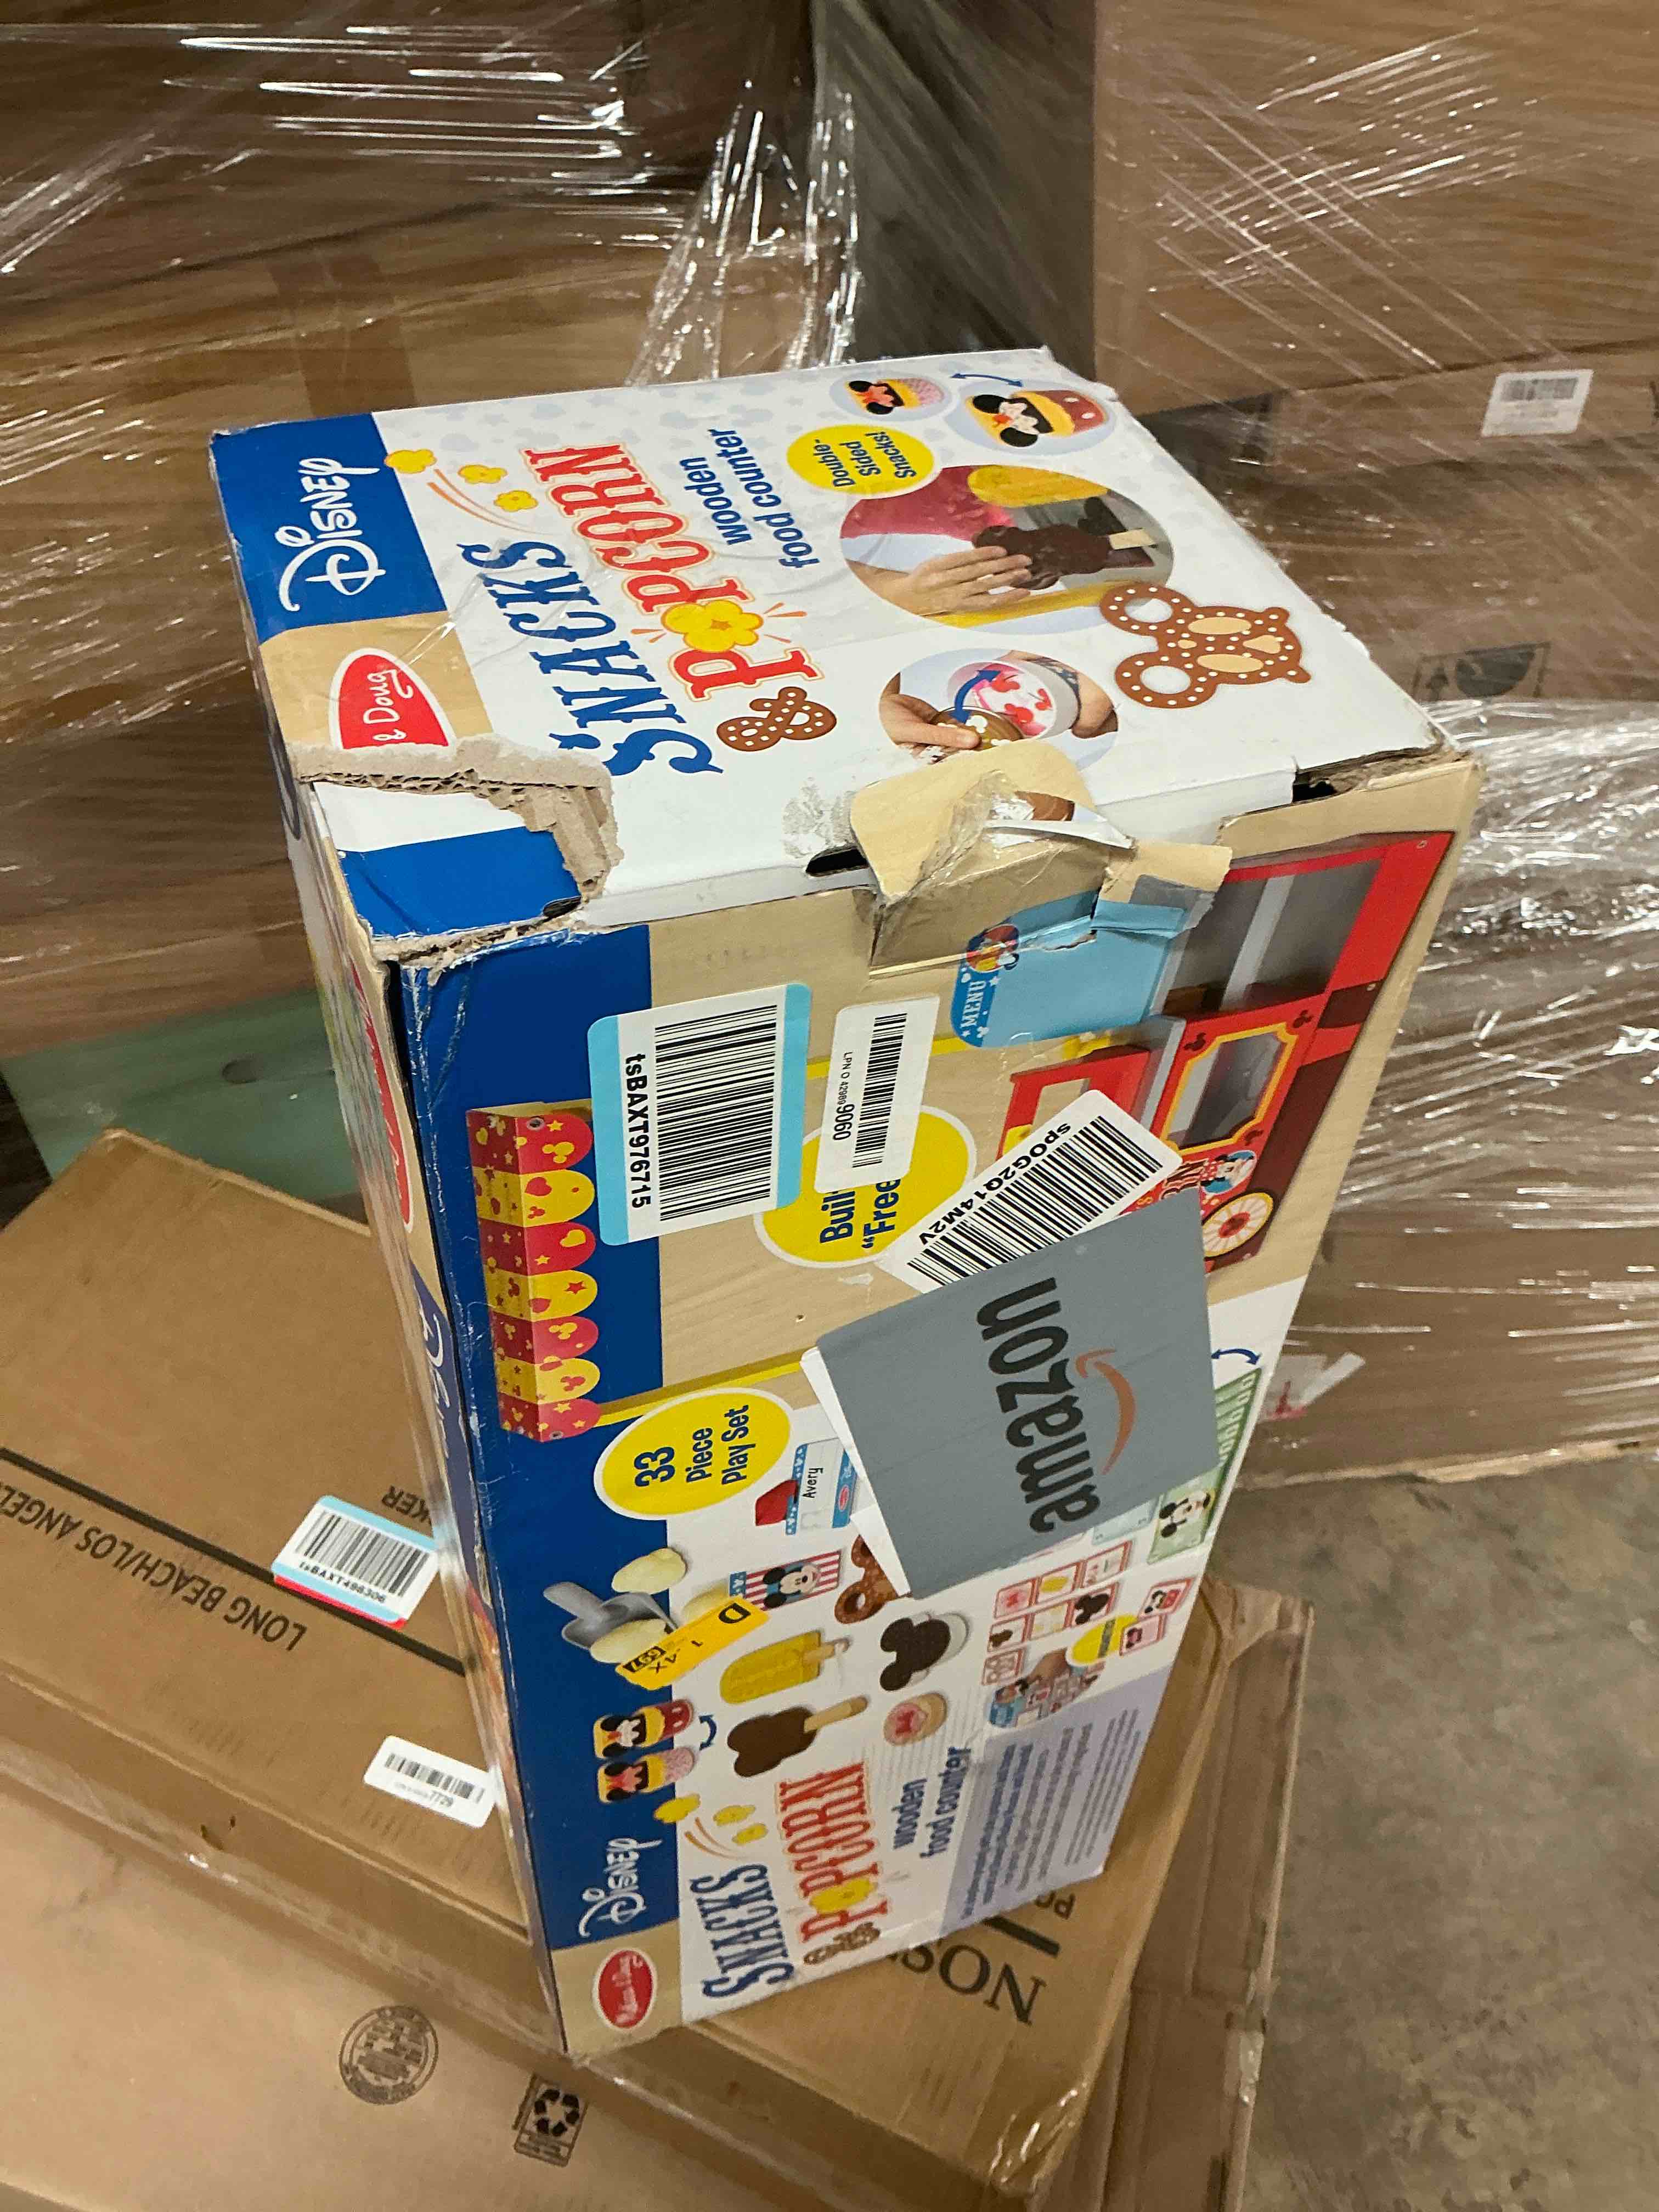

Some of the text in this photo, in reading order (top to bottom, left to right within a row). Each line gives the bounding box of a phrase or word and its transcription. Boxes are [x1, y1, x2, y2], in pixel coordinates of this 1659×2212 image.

[814, 439, 856, 487] Double-
[839, 441, 881, 476] Sided
[865, 432, 917, 478] Snacks!
[274, 456, 386, 612] Disney
[679, 456, 754, 545] wooden
[708, 429, 820, 568] food counter
[363, 668, 413, 724] Doug
[456, 541, 723, 776] SNACKS
[960, 980, 986, 1028] MENU
[624, 1053, 651, 1208] tsBAXT976715
[820, 1189, 856, 1243] Buil
[977, 1277, 1101, 1534] amazon
[634, 1446, 675, 1487] 33
[685, 1427, 713, 1483] Piece
[721, 1404, 757, 1485] Play Set
[382, 1485, 431, 1522] KER
[803, 1467, 823, 1499] Avery
[0, 1483, 308, 1651] LONG BEACH/LOS ANGEL
[891, 1779, 928, 1849] wooden
[920, 1747, 971, 1858] food counter
[578, 1837, 663, 1938] Disney
[690, 1865, 794, 1997] SNACKS
